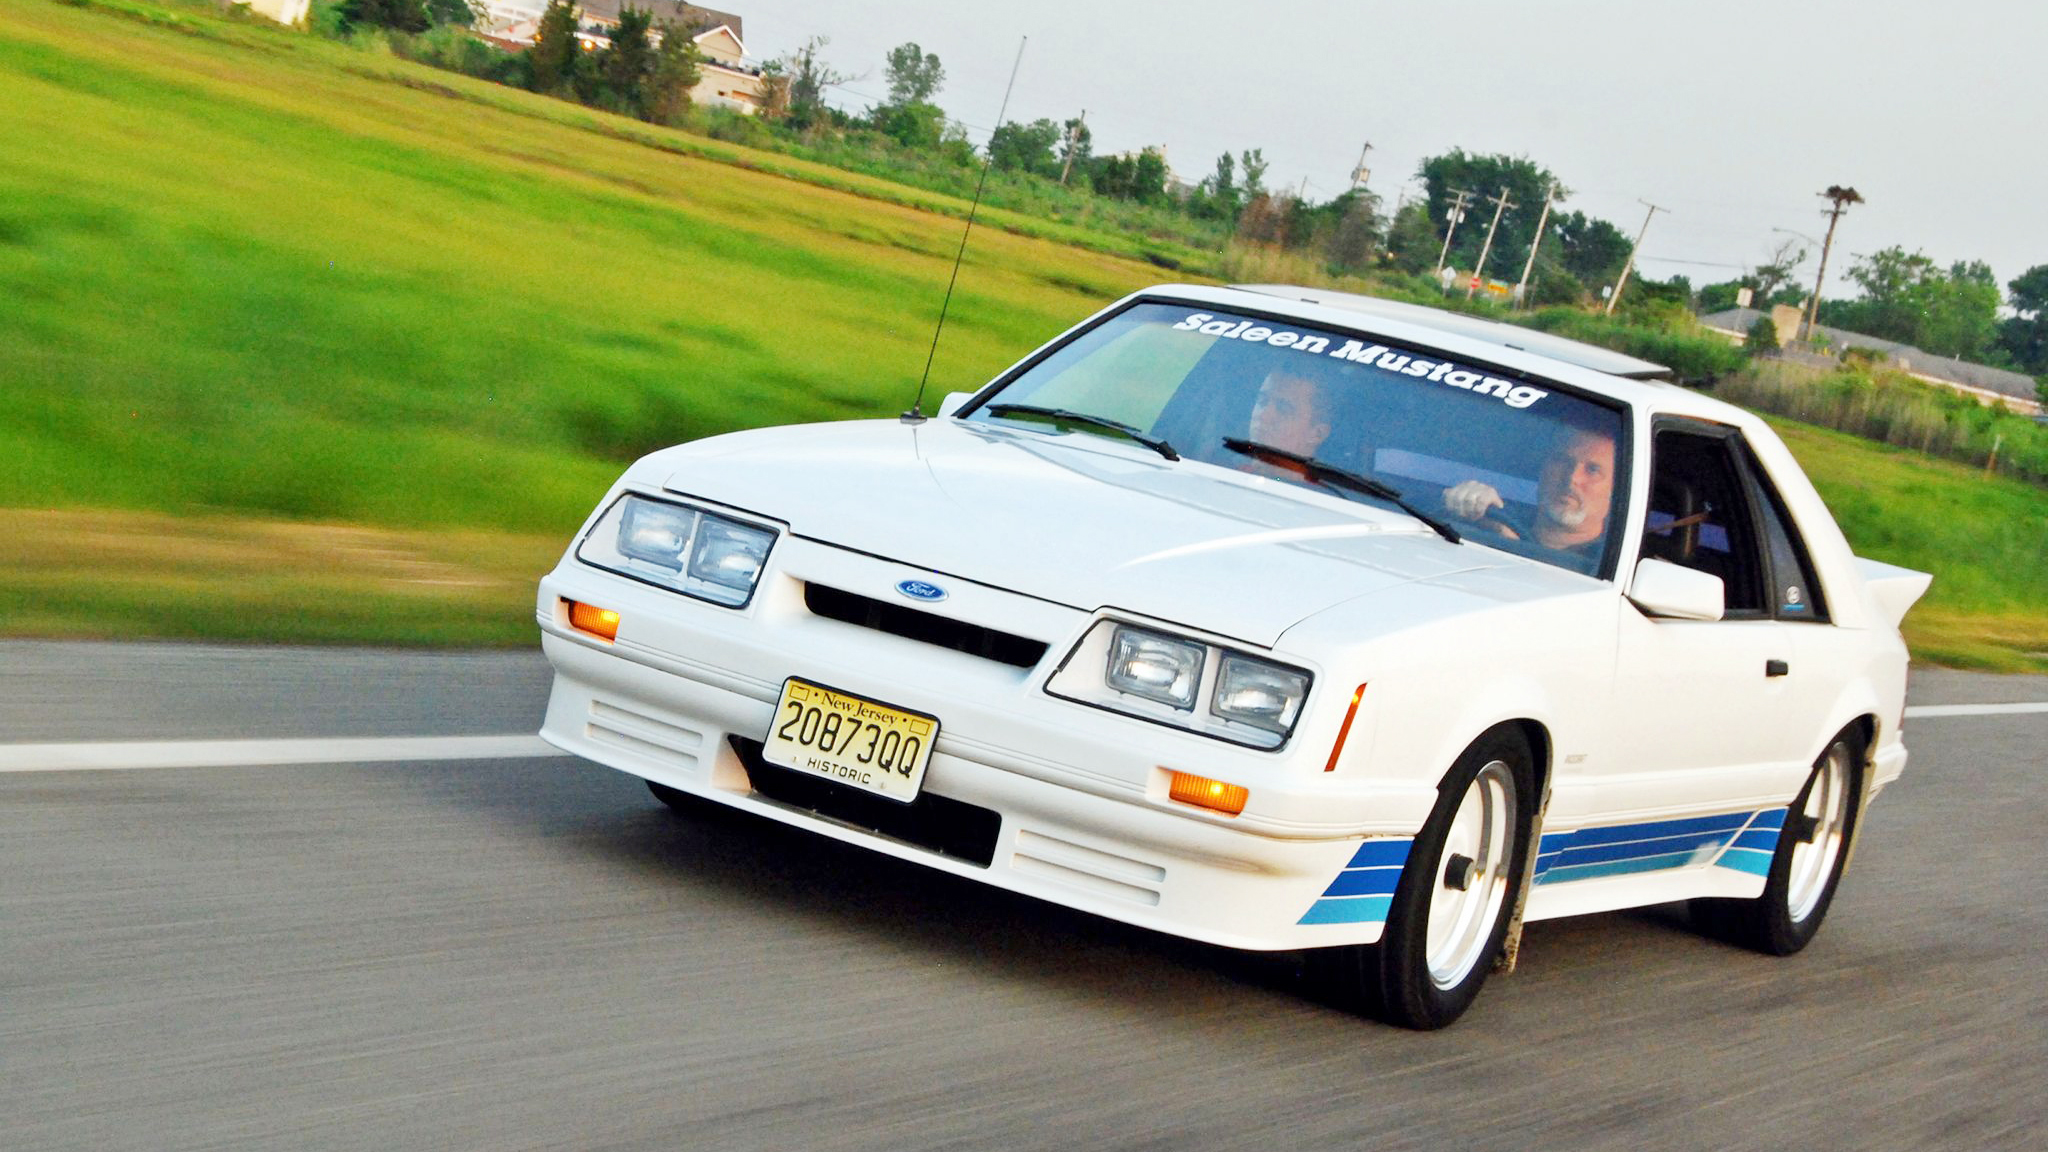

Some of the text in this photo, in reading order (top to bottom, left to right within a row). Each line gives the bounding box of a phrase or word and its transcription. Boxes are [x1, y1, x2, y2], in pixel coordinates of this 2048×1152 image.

[1173, 313, 1549, 409] Saleen Mustang
[906, 582, 936, 597] Ford
[821, 692, 899, 727] New Jersey
[778, 701, 921, 779] 20873QQ
[807, 757, 872, 785] HISTORIC
